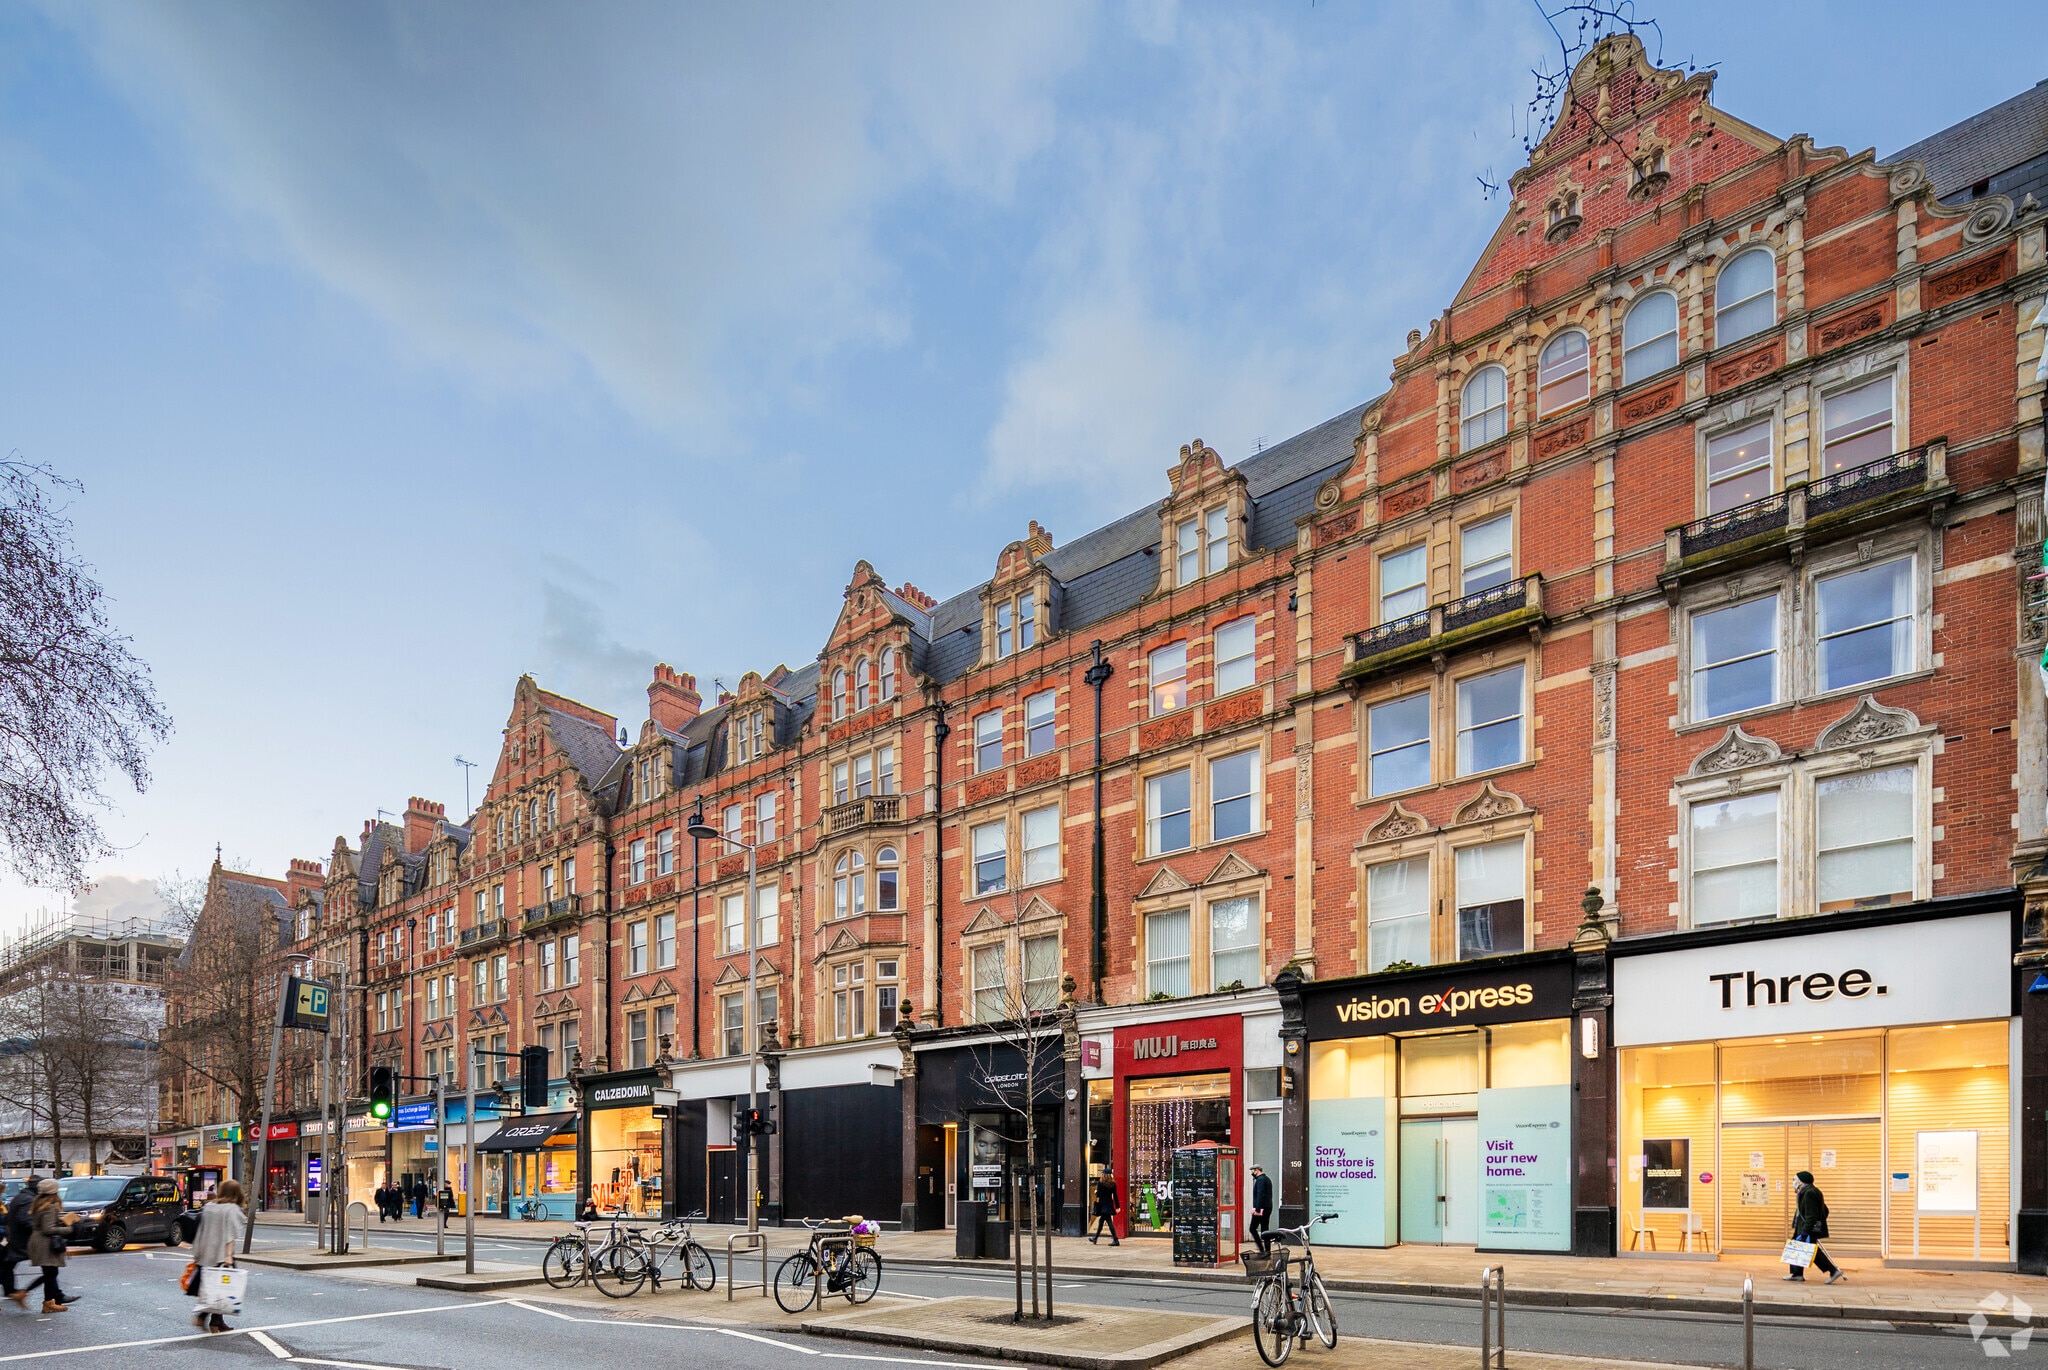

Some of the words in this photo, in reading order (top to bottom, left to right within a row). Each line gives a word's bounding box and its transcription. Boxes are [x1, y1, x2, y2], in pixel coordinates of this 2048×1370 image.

[1709, 968, 1888, 1010] Three.
[313, 990, 325, 1012] P
[1336, 994, 1410, 1023] vision
[1418, 983, 1534, 1017] express
[1133, 1035, 1178, 1060] MUJI
[595, 1084, 648, 1101] CALZEDONIA
[1315, 1145, 1346, 1158] Sorry,
[1486, 1140, 1514, 1151] Visit
[1315, 1157, 1335, 1167] this
[1337, 1158, 1363, 1167] store
[1365, 1157, 1375, 1167] is
[1486, 1155, 1508, 1164] our
[1511, 1154, 1538, 1163] new
[1315, 1170, 1338, 1179] now
[1340, 1168, 1377, 1179] closed.
[1486, 1165, 1526, 1177] home.
